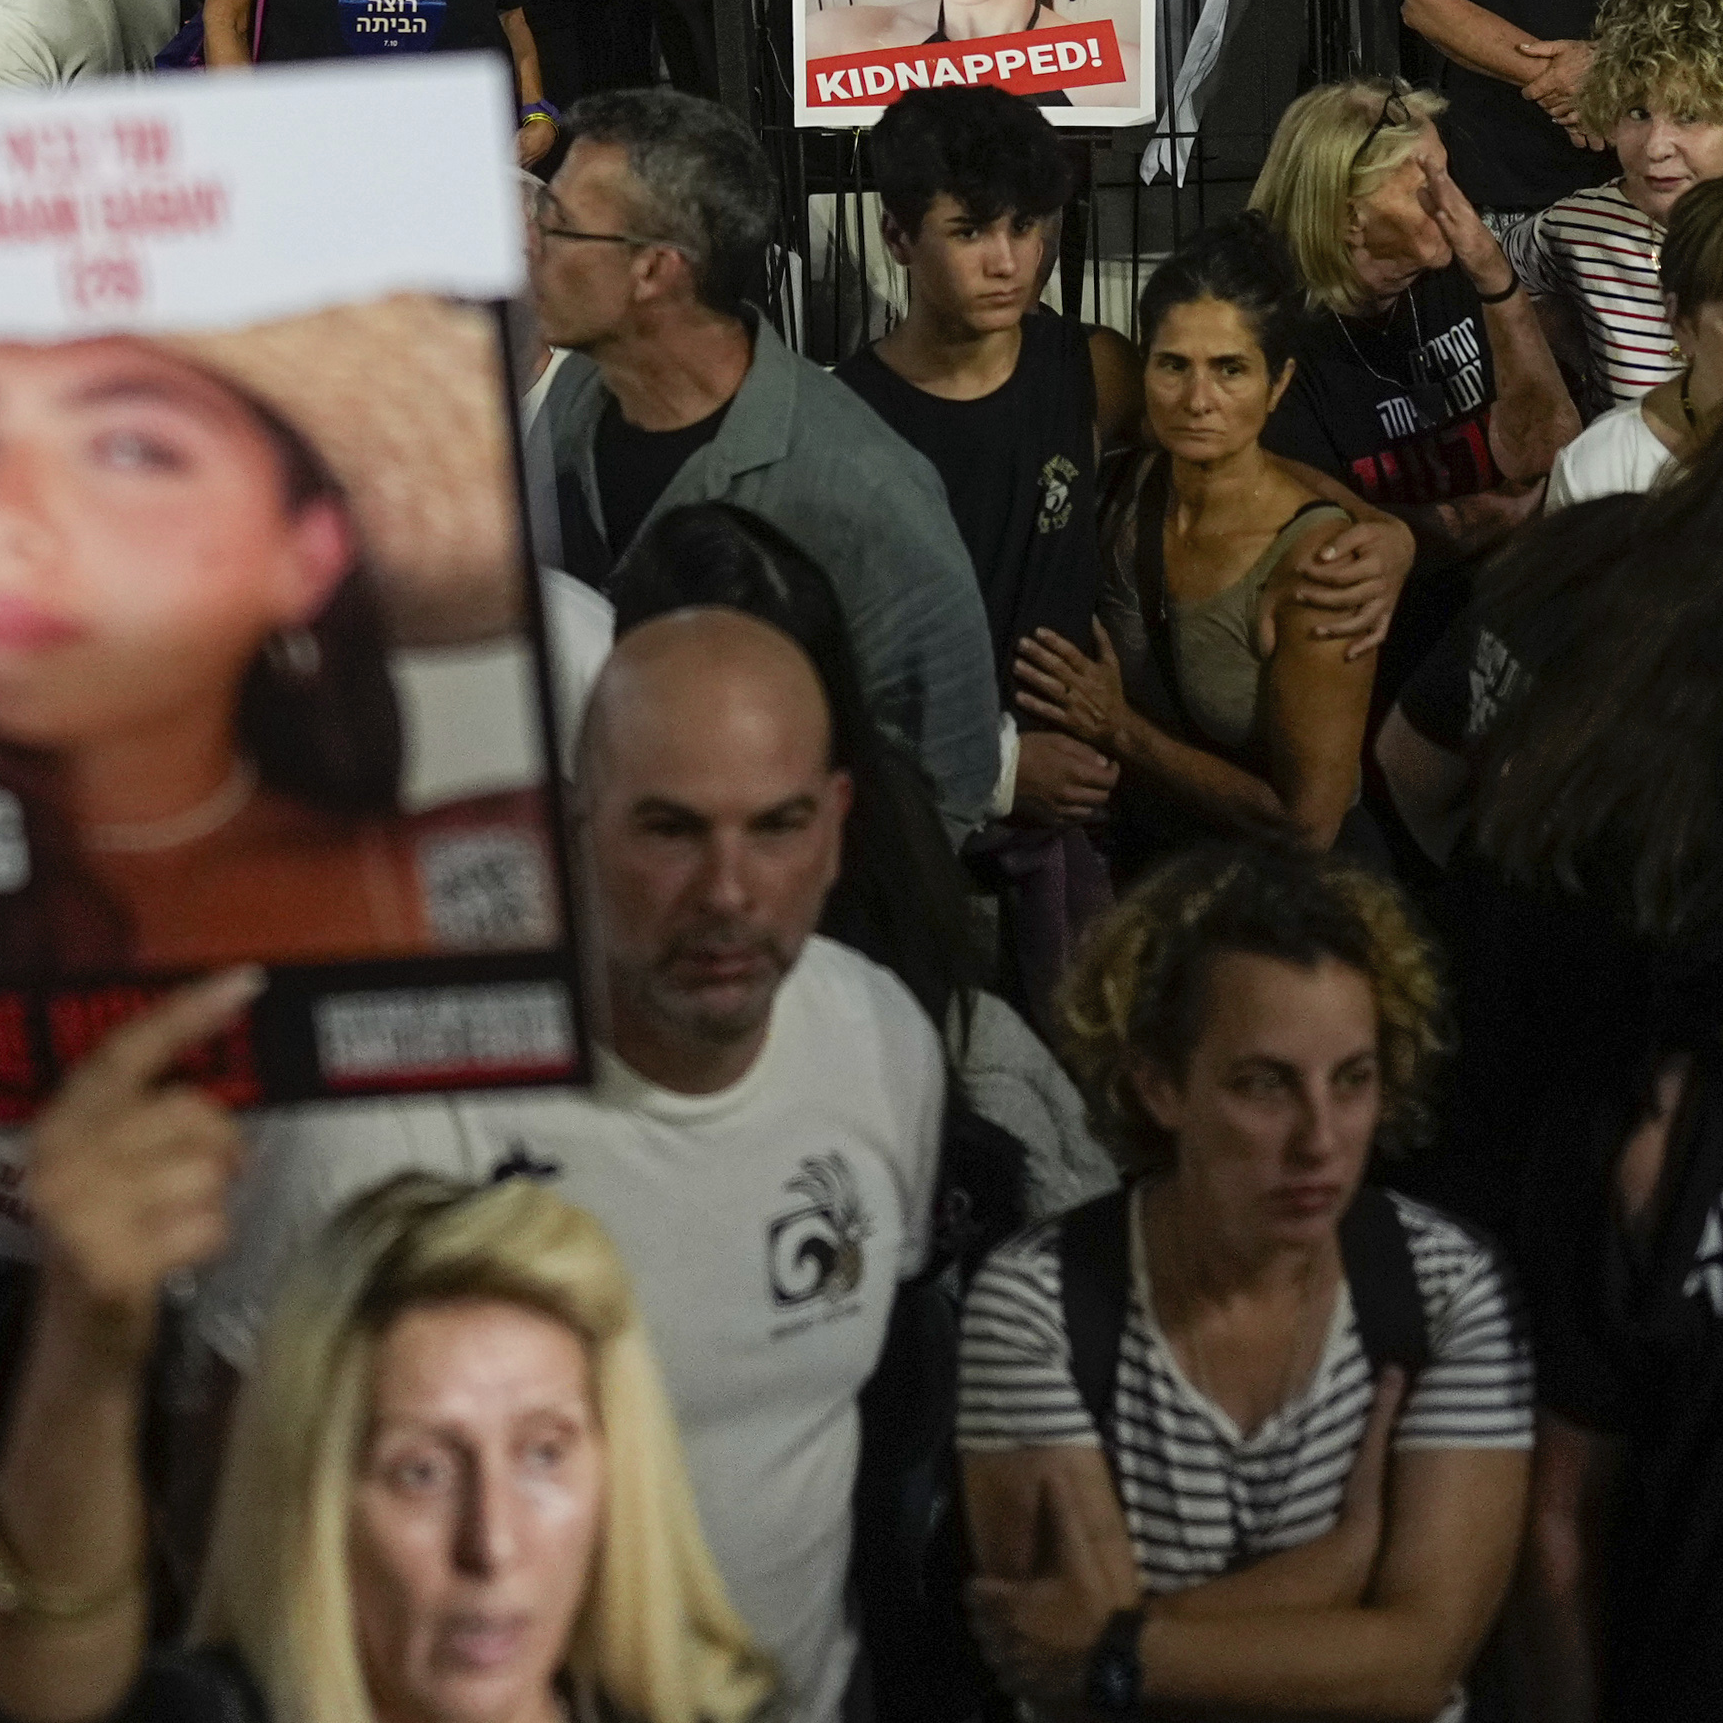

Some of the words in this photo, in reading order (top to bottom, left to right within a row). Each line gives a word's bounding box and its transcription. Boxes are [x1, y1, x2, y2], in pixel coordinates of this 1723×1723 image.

[356, 17, 427, 33] הביתה
[383, 39, 399, 47] 7.10
[815, 37, 1103, 104] KIDNAPPED!
